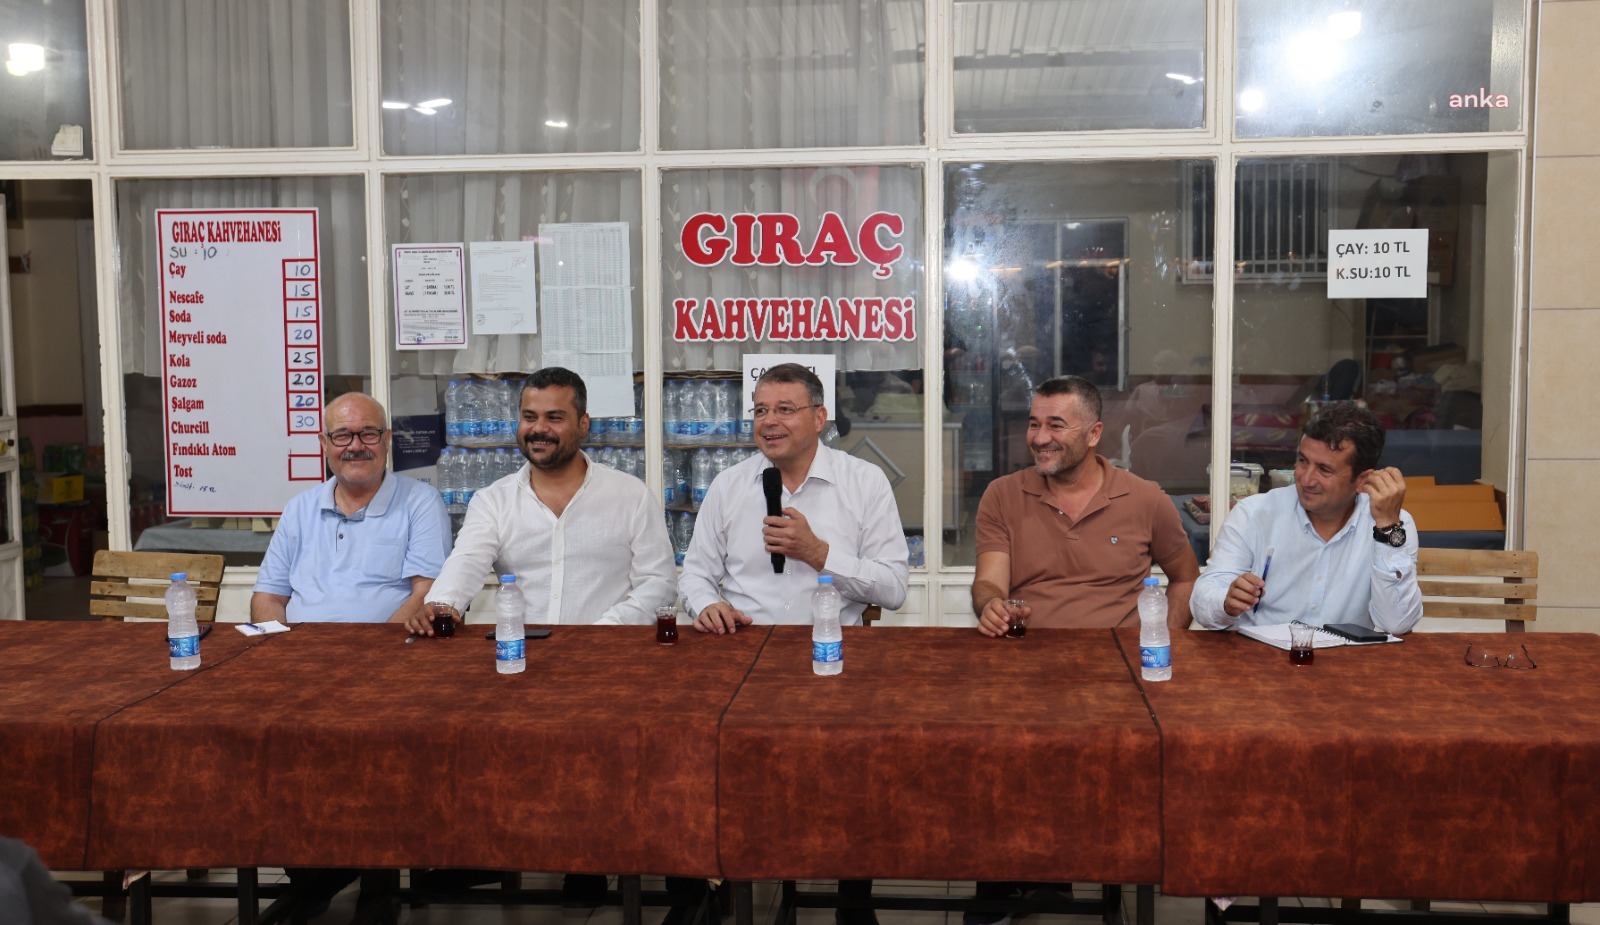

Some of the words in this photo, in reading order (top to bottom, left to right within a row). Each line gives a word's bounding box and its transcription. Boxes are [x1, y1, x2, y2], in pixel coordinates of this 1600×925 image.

[172, 221, 205, 248] GIRAÇ
[681, 211, 904, 279] GIRAÇ
[1336, 243, 1369, 258] ÇAY:
[1373, 242, 1390, 254] 10
[1394, 241, 1410, 253] TL
[169, 246, 187, 259] SU
[203, 246, 218, 260] 10
[169, 262, 186, 278] Çay
[295, 264, 311, 277] 10
[1395, 265, 1411, 278] TL
[169, 290, 205, 304] Nescafe
[294, 284, 313, 298] 15
[169, 310, 192, 323] Soda
[295, 305, 313, 318] 15
[169, 330, 205, 347] Meyveli
[206, 331, 227, 344] soda
[294, 329, 313, 340] 20
[169, 354, 191, 367] Kola
[292, 351, 316, 364] 25
[170, 375, 197, 388] Gazoz
[291, 373, 315, 386] 20
[171, 396, 205, 412] Şalgam
[295, 394, 315, 407] 20
[171, 421, 209, 434] Churcill
[295, 415, 316, 428] 30
[172, 443, 210, 456] Fındıklı
[212, 443, 236, 456] Atom
[174, 464, 193, 478] Tost
